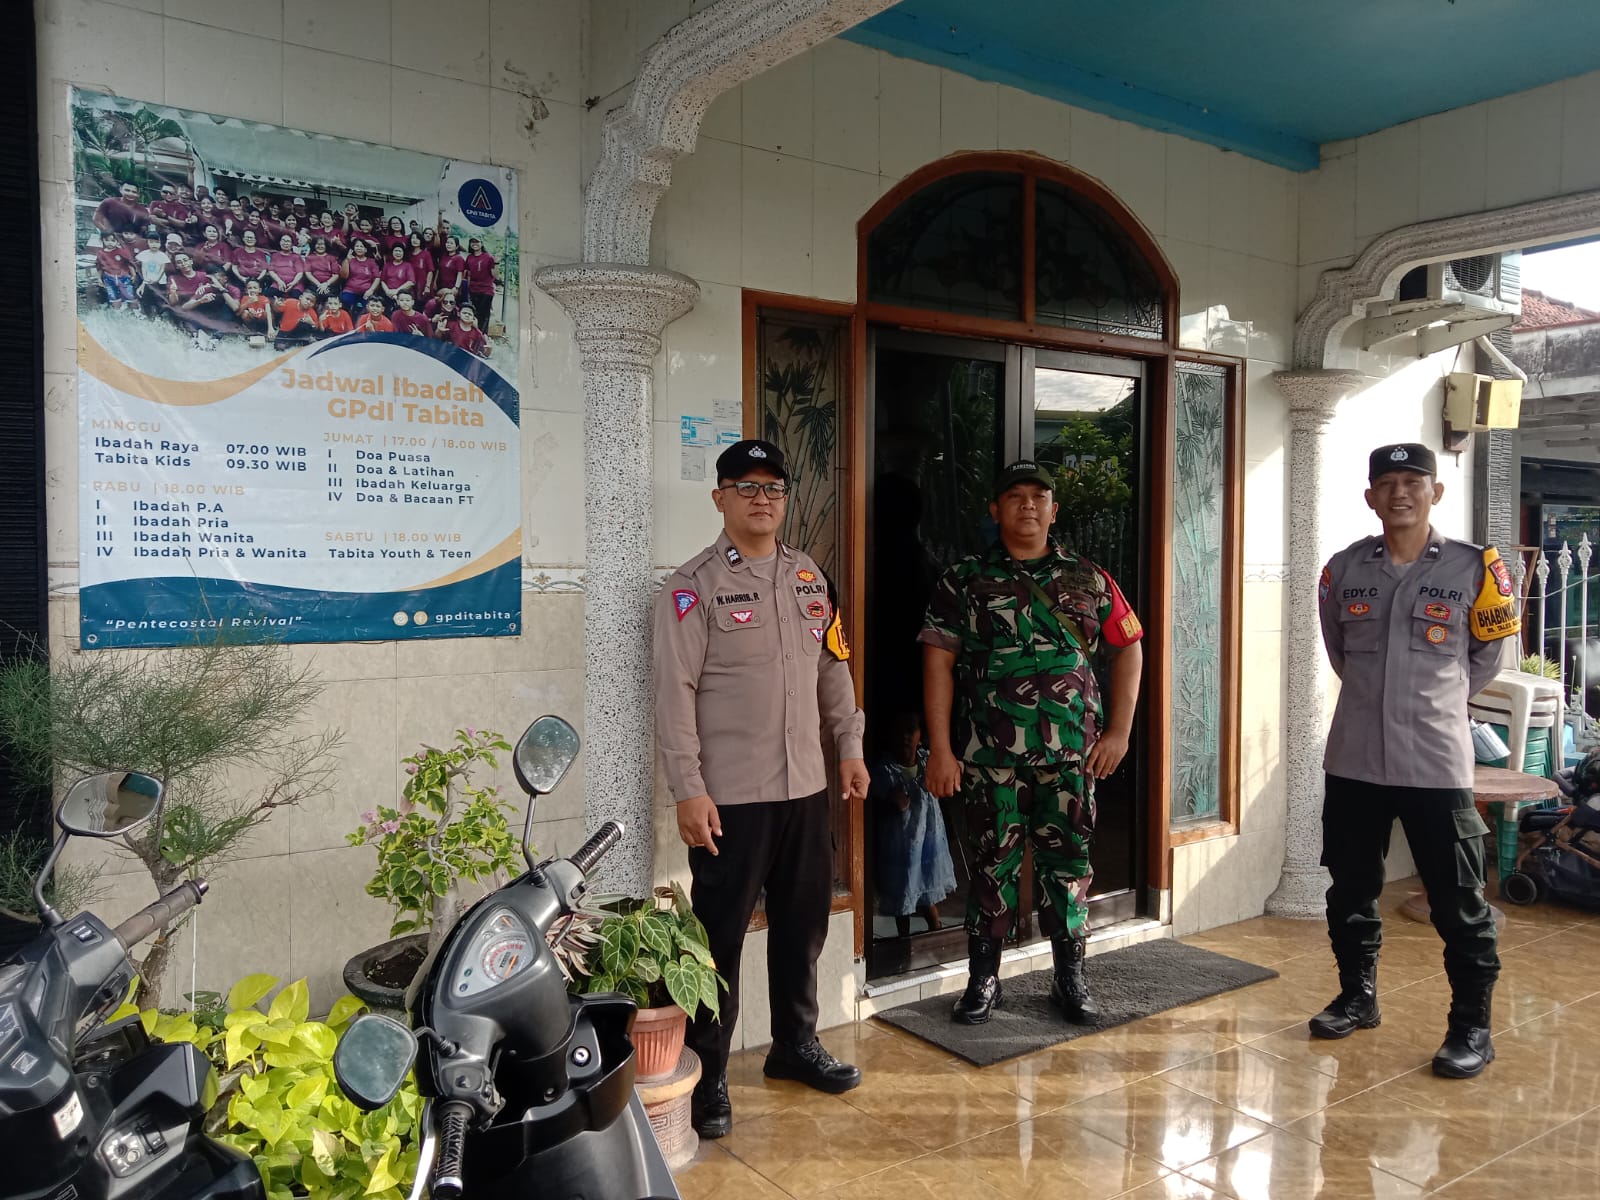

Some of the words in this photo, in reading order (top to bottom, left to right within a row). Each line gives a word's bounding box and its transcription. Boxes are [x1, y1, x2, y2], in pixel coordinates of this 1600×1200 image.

[281, 369, 383, 396] Jadwal
[394, 377, 484, 402] Ibadah
[328, 399, 393, 421] GPdI
[403, 403, 484, 427] Tabita
[92, 420, 161, 432] MINGGU
[95, 437, 153, 450] Ibadah
[161, 440, 199, 453] Raya
[226, 444, 269, 455] 07.00
[276, 446, 306, 456] WIB
[323, 432, 373, 443] JUMAT
[392, 436, 426, 447] 17.00
[442, 438, 475, 449] 18.00
[481, 441, 506, 451] WIB
[95, 453, 148, 465] Tabita
[155, 455, 191, 466] Kids
[227, 459, 269, 470] 09.30
[276, 461, 306, 471] WIB
[356, 451, 382, 460] Doa
[389, 452, 430, 462] Puasa
[328, 464, 337, 473] II
[356, 465, 383, 474] Doa
[389, 466, 397, 475] &
[403, 467, 454, 477] Latihan
[93, 481, 140, 492] RABU
[164, 483, 205, 494] 18.00
[213, 485, 245, 495] WIB
[328, 478, 342, 487] III
[356, 479, 405, 489] Ibadah
[411, 481, 471, 492] Keluarga
[328, 492, 342, 501] IV
[357, 493, 383, 503] Doa
[390, 493, 398, 503] &
[405, 494, 453, 504] Bacaan
[459, 496, 474, 504] FT
[134, 501, 190, 512] Ibadah
[197, 503, 224, 512] P.A
[97, 515, 106, 525] II
[134, 516, 190, 527] Ibadah
[198, 517, 229, 527] Pria
[97, 531, 112, 541] III
[134, 532, 191, 542] Ibadah
[200, 533, 254, 543] Wanita
[325, 532, 373, 542] SABTU
[393, 533, 428, 542] 18.00
[434, 534, 461, 542] WIB
[97, 547, 113, 556] IV
[134, 547, 191, 557] Ibadah
[200, 548, 229, 557] Pria
[236, 548, 245, 557] &
[252, 548, 306, 558] Wanita
[329, 549, 374, 558] Tabita
[381, 549, 420, 558] Youth
[427, 549, 434, 558] &
[440, 549, 471, 558] Teen
[796, 584, 825, 596] POLRI
[1419, 586, 1463, 601] POLRI
[435, 611, 511, 623] gpditabita
